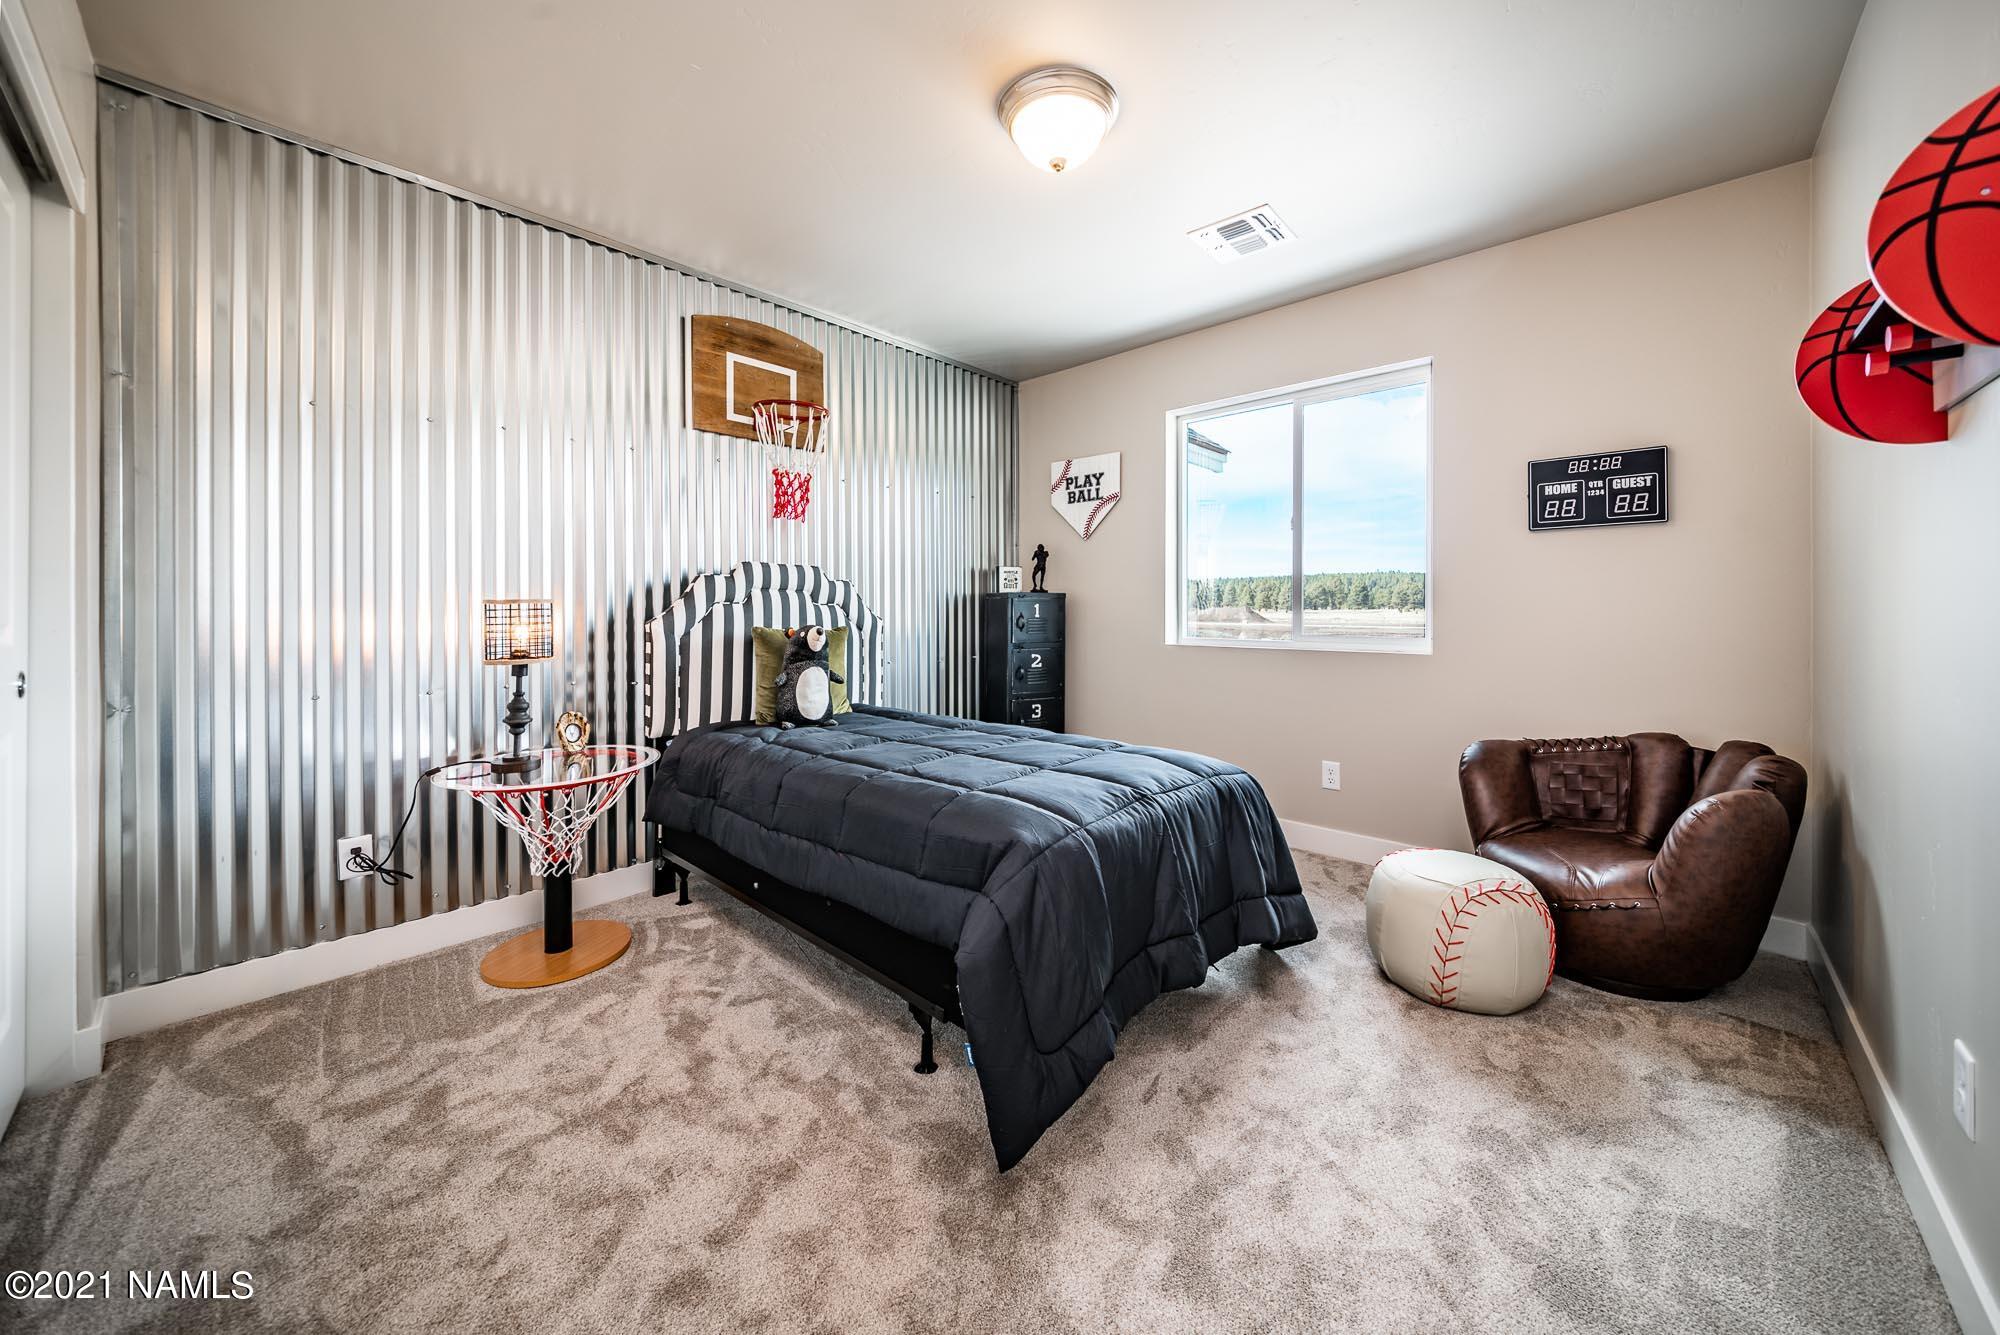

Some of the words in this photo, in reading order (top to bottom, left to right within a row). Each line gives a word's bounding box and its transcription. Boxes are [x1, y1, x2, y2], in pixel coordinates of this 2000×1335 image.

[1065, 472, 1105, 491] PLAY
[1544, 482, 1578, 496] HOME
[1588, 480, 1604, 488] QTR
[1612, 475, 1653, 490] GUEST
[1067, 487, 1104, 505] BALL
[1587, 489, 1605, 497] 1234
[1033, 603, 1041, 618] 1
[1031, 653, 1042, 668] 2
[1031, 703, 1042, 719] 3
